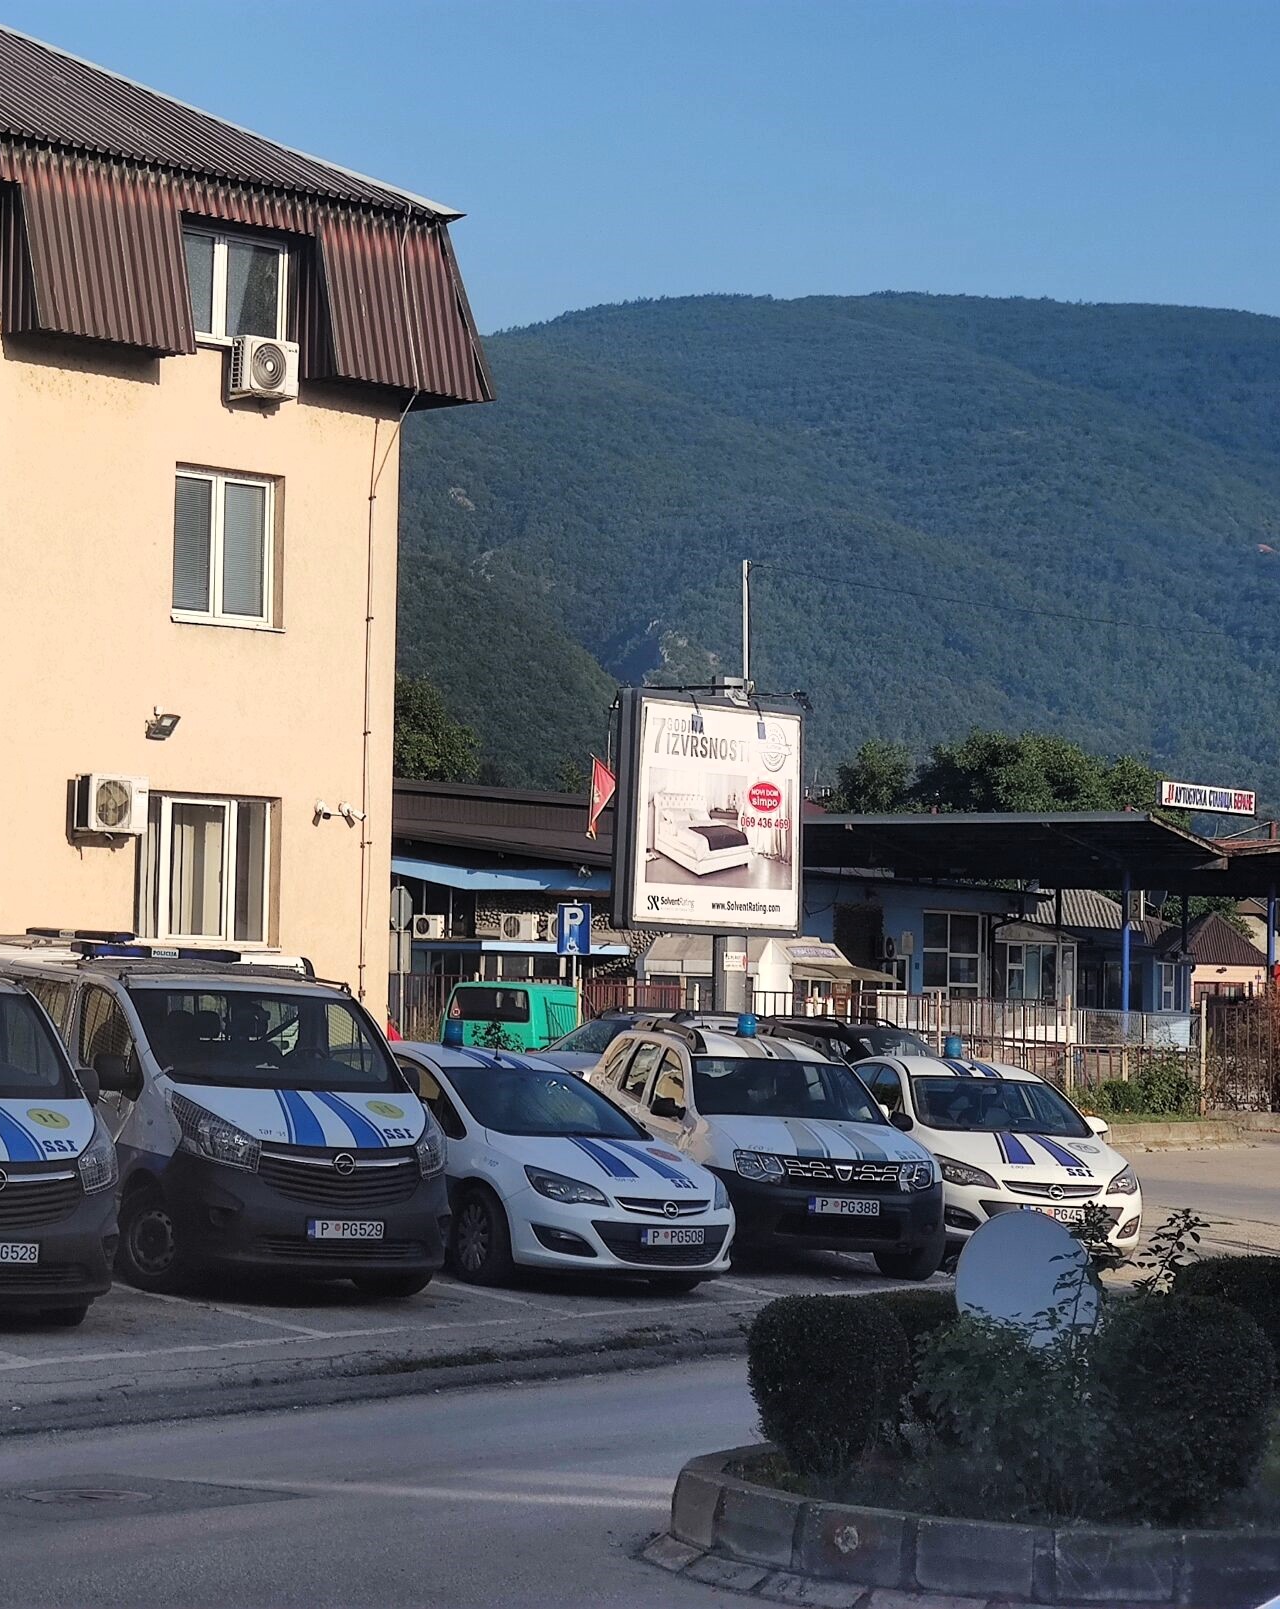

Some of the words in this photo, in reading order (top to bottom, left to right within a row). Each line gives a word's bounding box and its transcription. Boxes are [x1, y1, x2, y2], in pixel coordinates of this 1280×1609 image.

[667, 718, 704, 735] GODINA
[653, 717, 666, 753] 7
[752, 796, 778, 808] simpo
[741, 817, 755, 827] 069
[758, 818, 772, 828] 436
[774, 819, 789, 829] 469
[711, 901, 780, 914] www.SolventRating.com
[1132, 901, 1139, 912] 5
[563, 907, 584, 935] P
[821, 1200, 829, 1211] P
[840, 1200, 878, 1214] PG388
[321, 1222, 330, 1237] P
[342, 1222, 383, 1237] PG529
[652, 1229, 660, 1243] P
[670, 1229, 704, 1244] PG508
